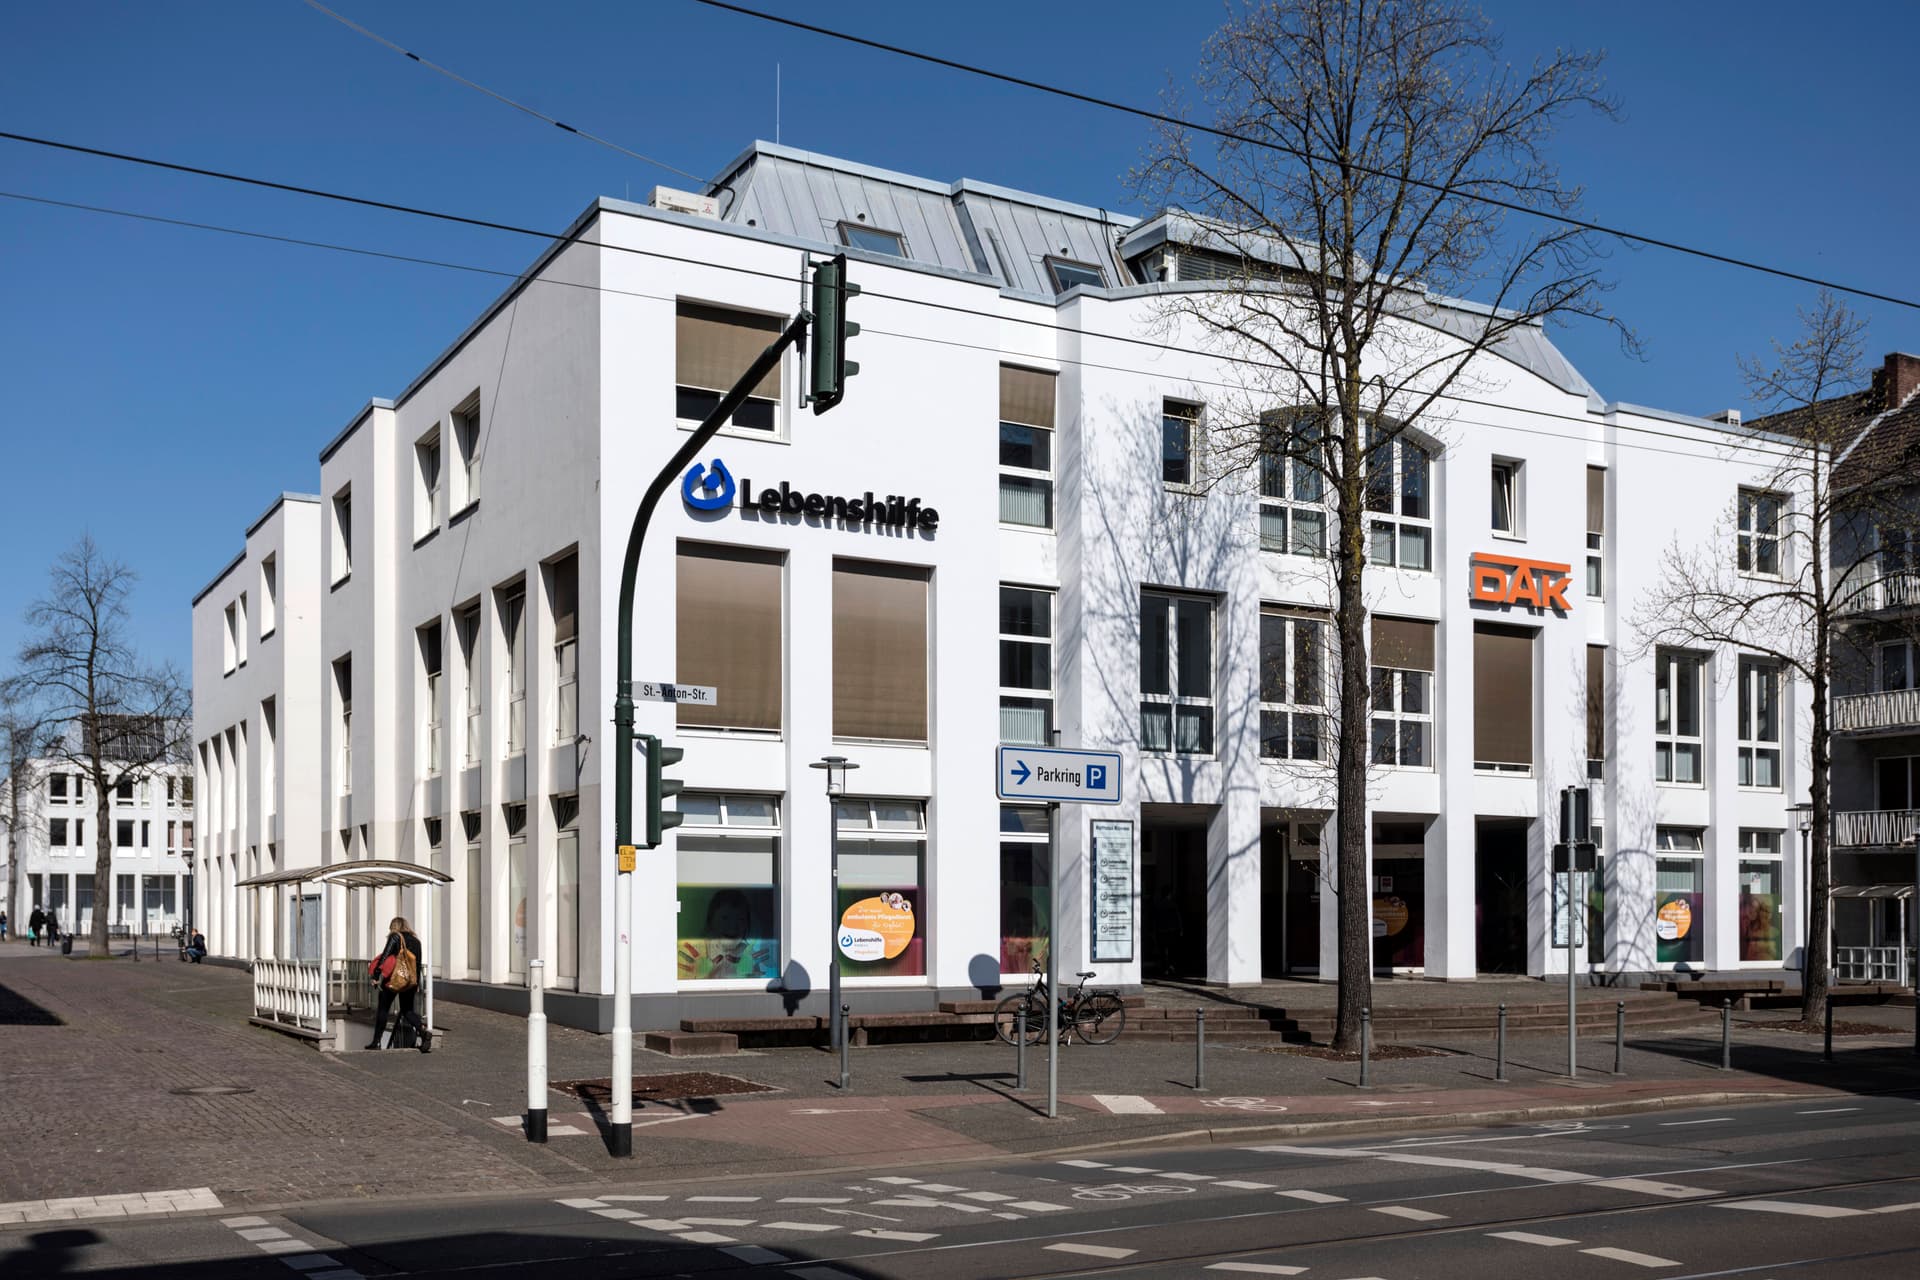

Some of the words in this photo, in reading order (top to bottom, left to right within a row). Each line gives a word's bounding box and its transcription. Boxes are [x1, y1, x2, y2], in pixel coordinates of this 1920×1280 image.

[740, 478, 939, 530] Lebenshilfe
[1470, 552, 1574, 611] DAK
[643, 684, 708, 701] St.-Anton-Str.
[1037, 766, 1081, 787] Parkring
